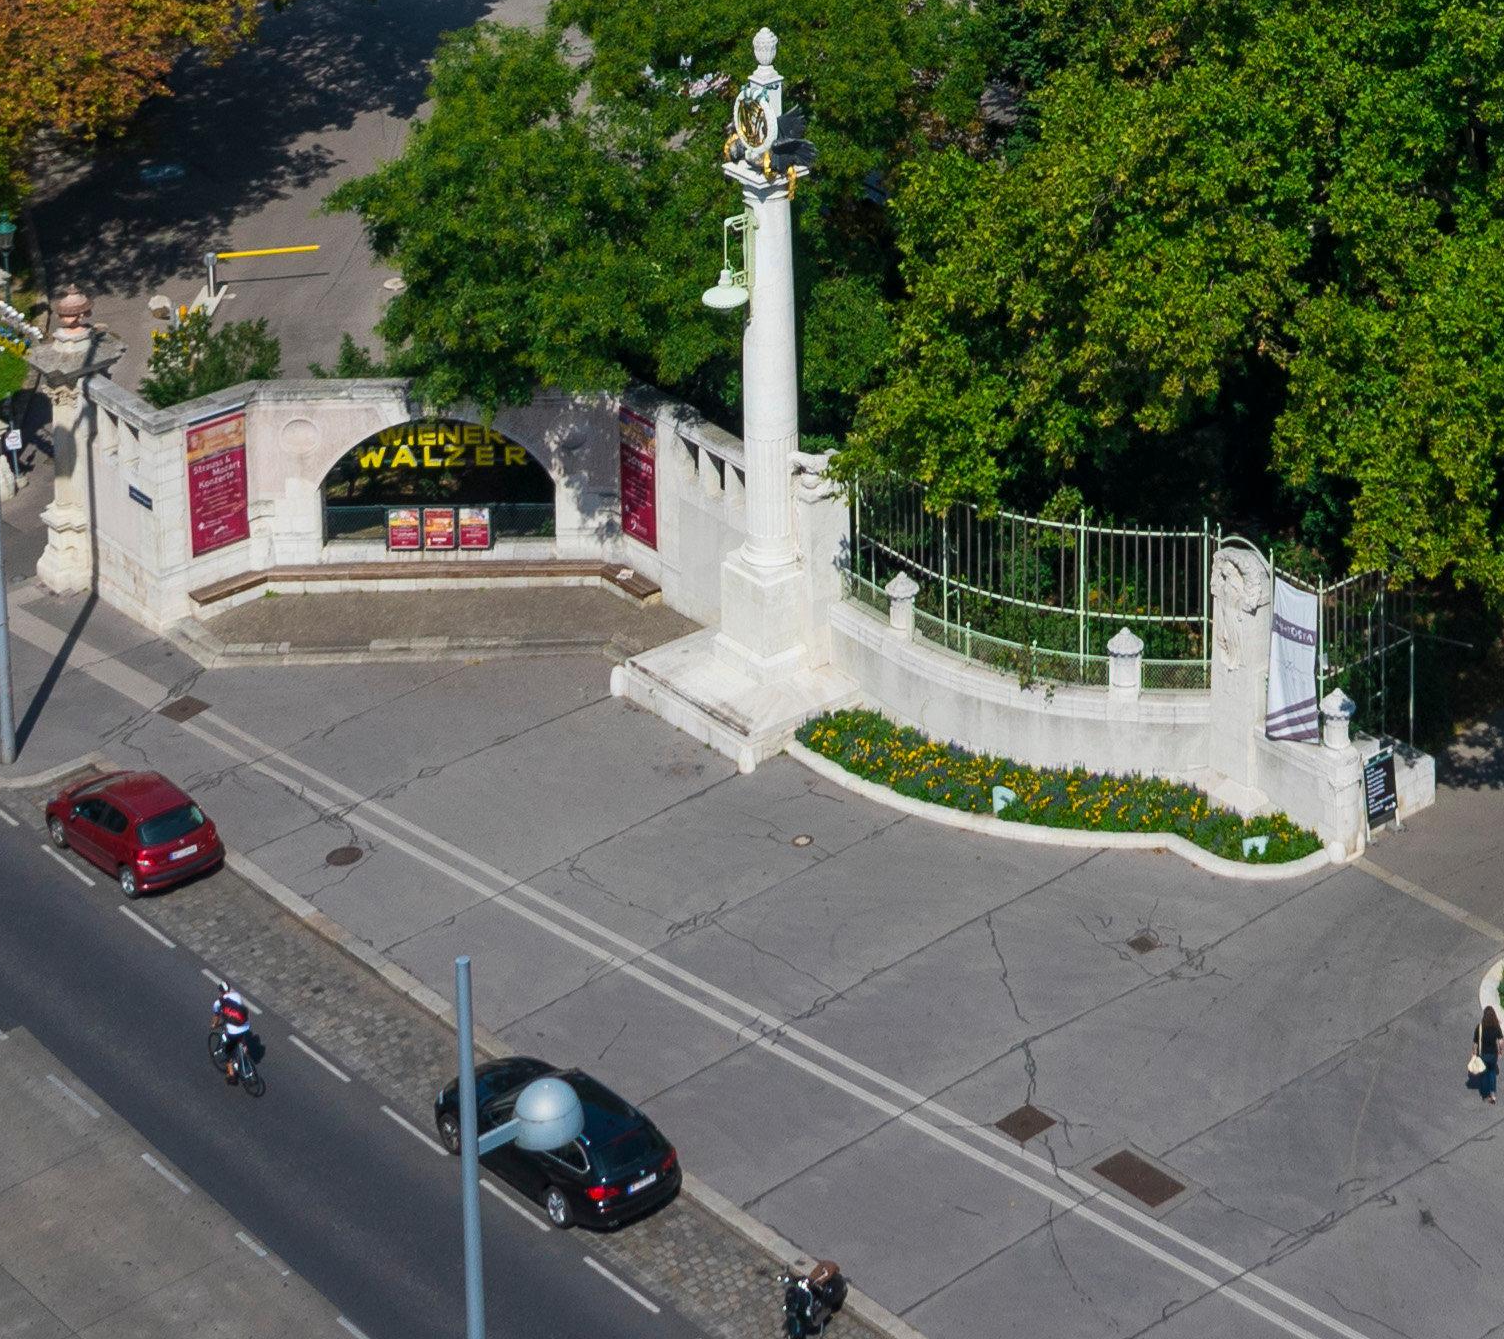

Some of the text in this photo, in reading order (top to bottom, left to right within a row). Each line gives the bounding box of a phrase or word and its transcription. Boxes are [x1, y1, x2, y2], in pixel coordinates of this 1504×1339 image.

[379, 425, 506, 446] WIENER
[193, 454, 231, 475] Strauss &
[357, 444, 527, 468] WALZER
[212, 460, 241, 476] Mozart
[198, 471, 235, 489] Konzerte
